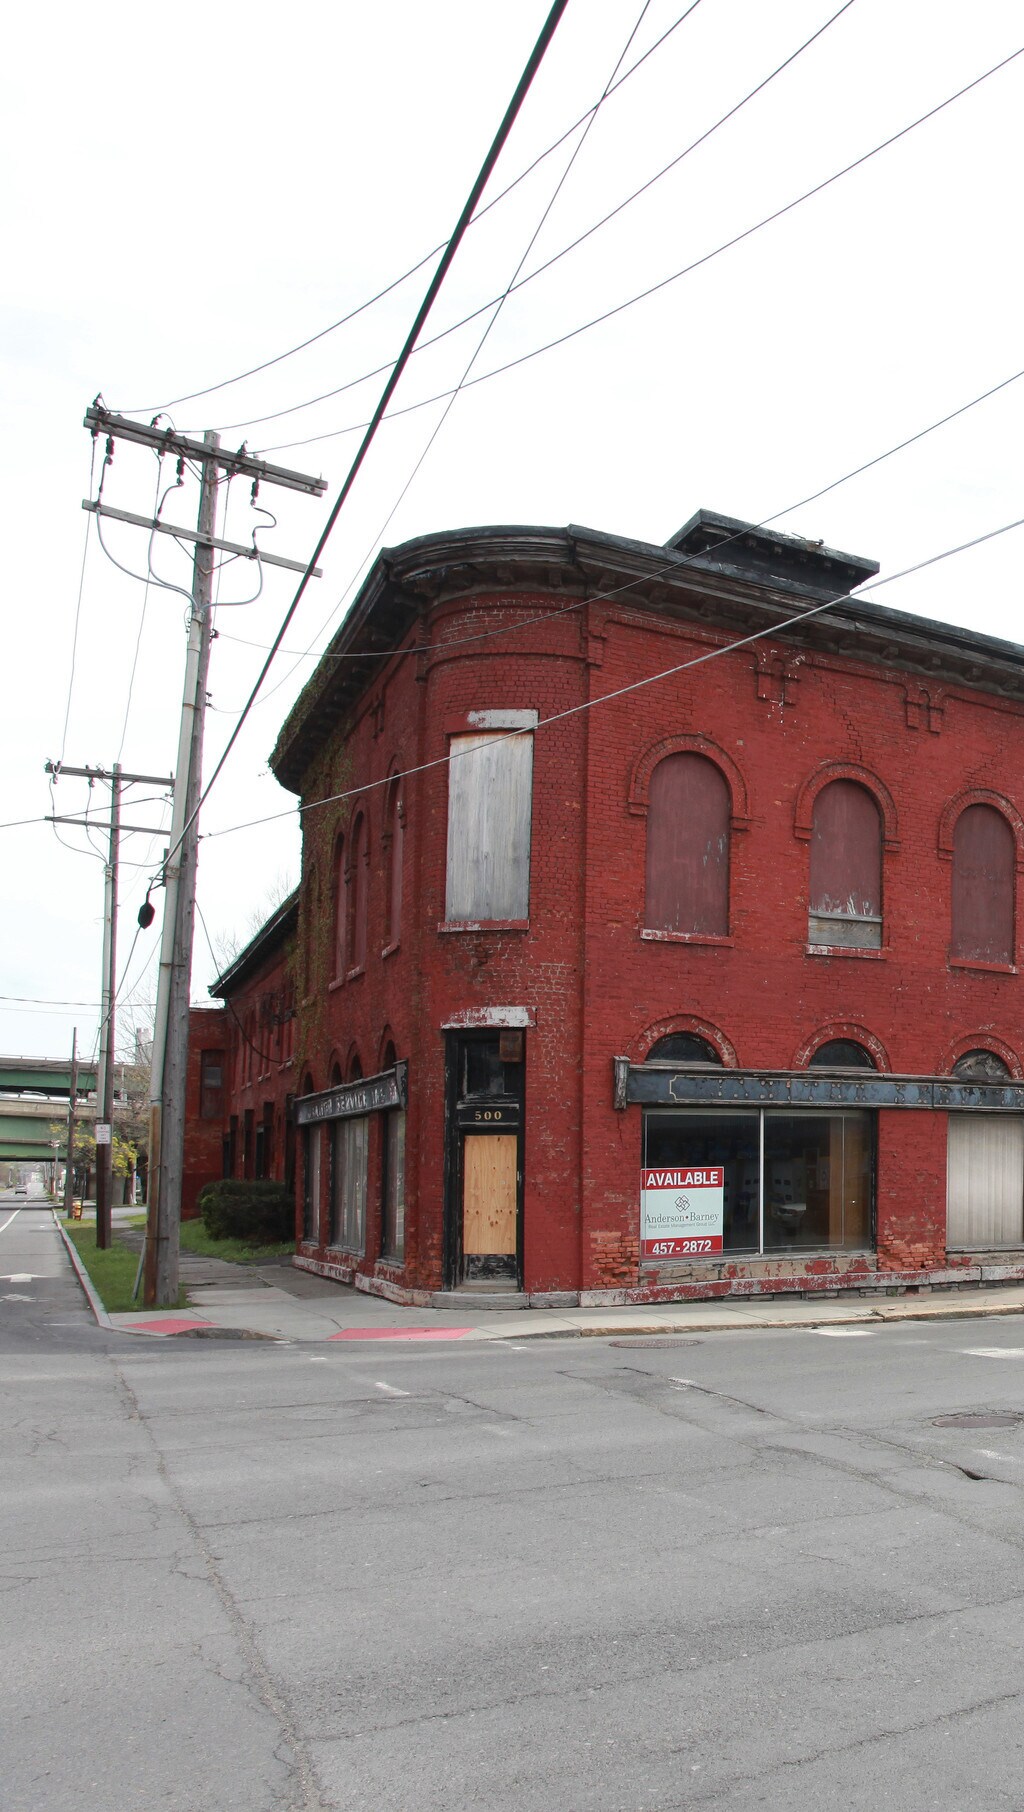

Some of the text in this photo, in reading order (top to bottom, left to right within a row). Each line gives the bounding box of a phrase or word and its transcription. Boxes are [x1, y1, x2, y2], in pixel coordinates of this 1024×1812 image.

[474, 1110, 502, 1120] 500
[646, 1171, 719, 1187] AVAILABLE
[644, 1211, 720, 1224] Anderson Barney
